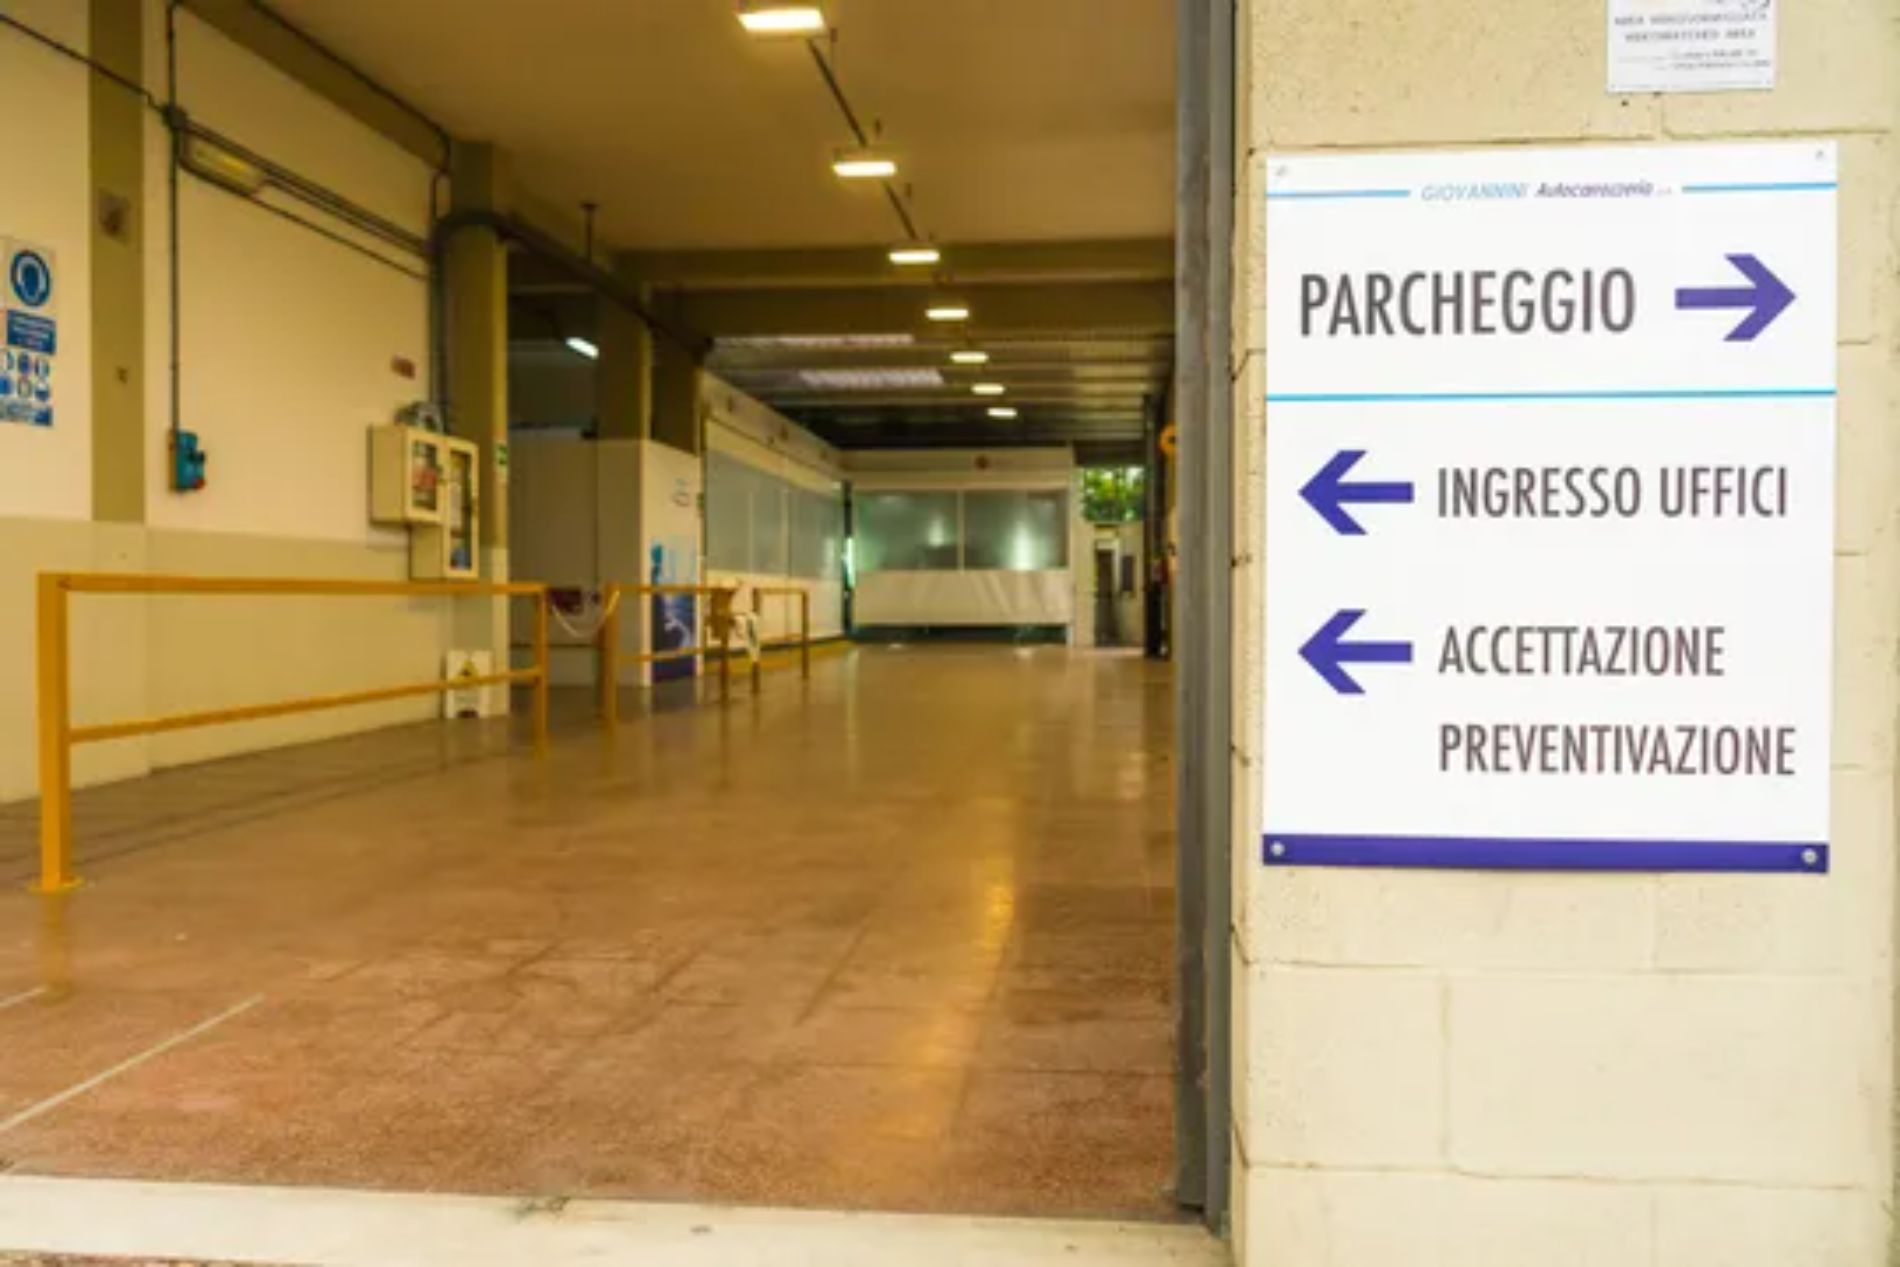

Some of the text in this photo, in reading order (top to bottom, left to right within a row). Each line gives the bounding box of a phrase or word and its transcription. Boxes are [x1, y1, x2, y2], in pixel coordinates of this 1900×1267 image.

[1421, 182, 1529, 201] GIOVANNINI
[1300, 268, 1636, 337] PARCHEGGIO
[1437, 466, 1787, 518] INGRESSO UFFICI
[1437, 625, 1726, 677] ACCETTAZIONE
[1439, 724, 1797, 777] PREVENTIVAZIONE
